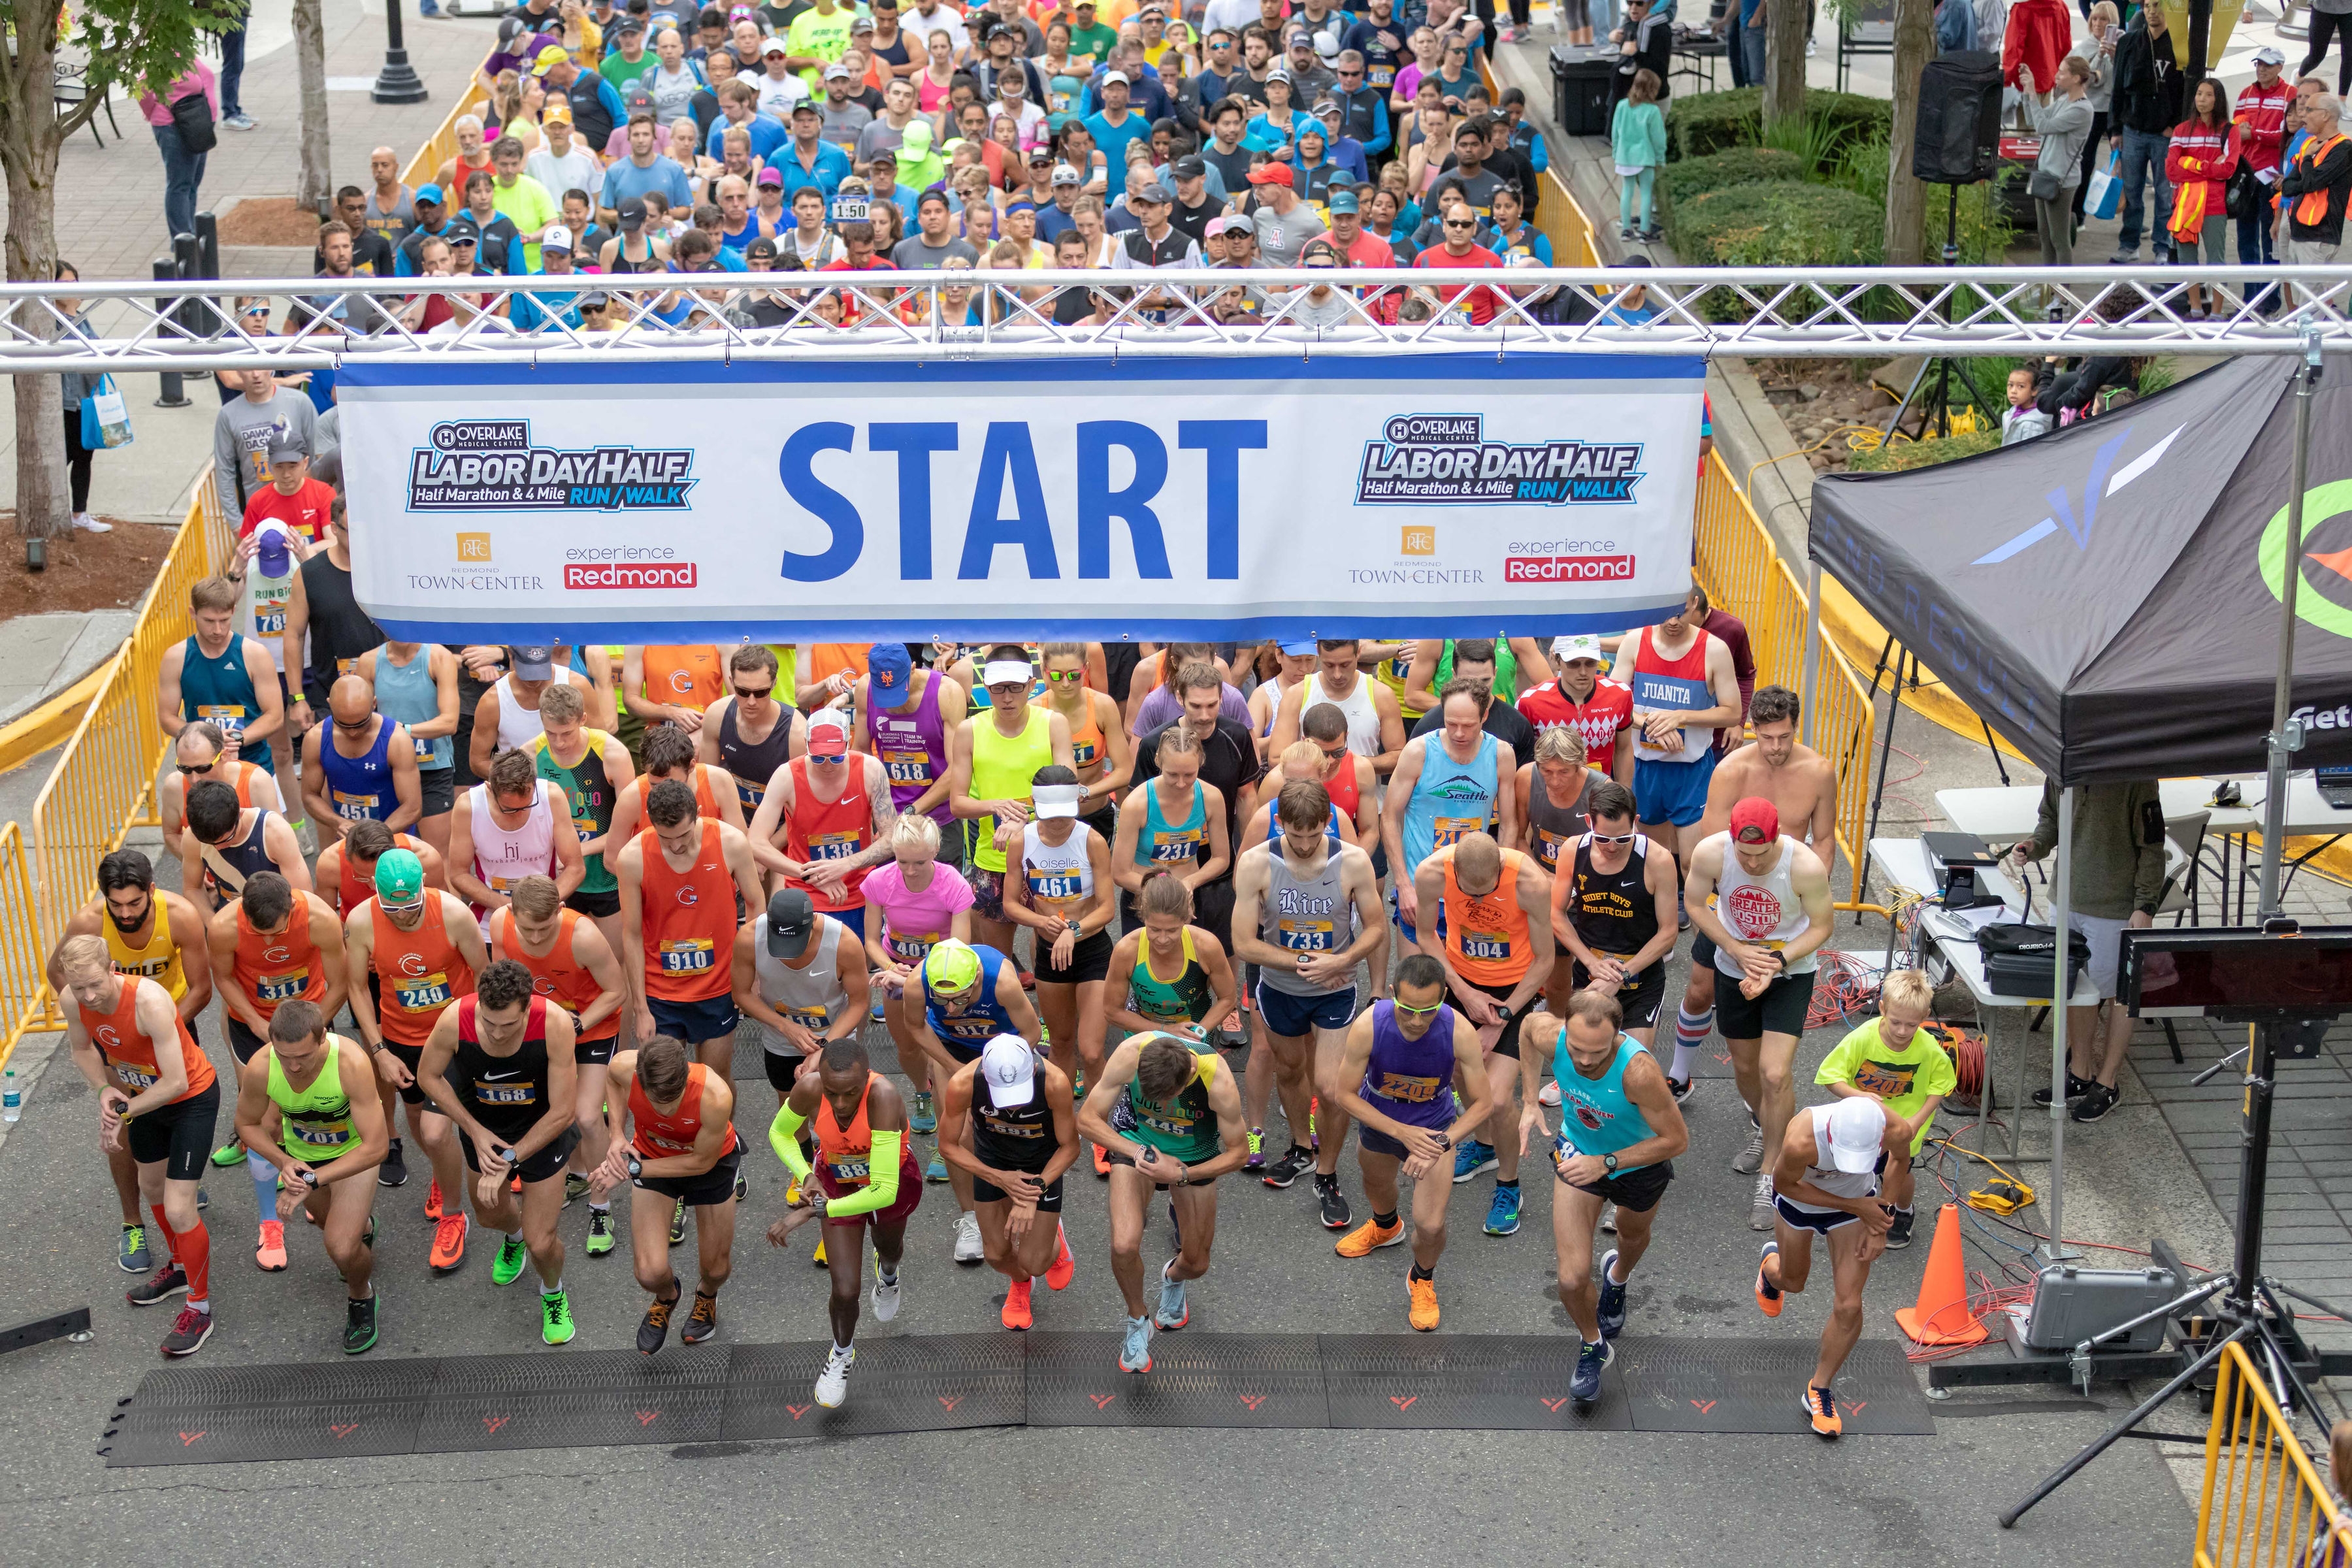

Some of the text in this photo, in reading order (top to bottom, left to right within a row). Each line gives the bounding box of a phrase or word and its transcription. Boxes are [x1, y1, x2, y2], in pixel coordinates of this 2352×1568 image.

[1371, 72, 1391, 84] 455
[838, 204, 866, 218] 1:50
[1266, 227, 1284, 250] A
[242, 427, 272, 441] DAWG
[457, 426, 523, 441] OVERLAKE
[1410, 420, 1475, 434] OVERLAKE
[416, 451, 525, 485] LABOR
[1366, 445, 1477, 479] LABOR
[416, 488, 444, 501] Half
[446, 487, 509, 501] Marathon
[512, 487, 523, 500] &
[525, 487, 535, 499] 4
[538, 486, 566, 500] Mile
[1364, 481, 1394, 495] Half
[1395, 481, 1458, 495] Marathon
[1461, 482, 1471, 494] &
[1474, 481, 1484, 493] 4
[1486, 480, 1514, 494] Mile
[779, 419, 1267, 582] START
[566, 544, 674, 563] experience
[1508, 537, 1615, 556] experience
[568, 563, 693, 587] Redmond
[1509, 555, 1631, 579] Redmond
[408, 575, 544, 590] TOWN CENTER
[1348, 569, 1485, 583] TOWN CENTER
[255, 590, 278, 599] RUN
[1642, 681, 1690, 704] JUANITA
[2289, 704, 2352, 731] Get
[890, 763, 924, 780] 618
[1446, 789, 1489, 801] Seattle
[340, 804, 370, 821] 451
[505, 843, 519, 860] hj
[818, 842, 853, 860] 138
[1158, 842, 1192, 861] 231
[1040, 858, 1079, 869] oiselle
[1039, 877, 1074, 897] 461
[1279, 889, 1333, 916] Rice
[1582, 892, 1631, 908] BIDET BOYS
[1729, 896, 1781, 913] GREATER
[1582, 904, 1633, 918] ATHLETIC CLUB
[1732, 908, 1778, 924] BOSTON
[896, 941, 930, 957] 401
[1287, 932, 1325, 951] 733
[1466, 939, 1502, 958] 304
[668, 952, 707, 970] 910
[264, 980, 302, 1000] 311
[404, 986, 444, 1007] 240
[954, 1024, 990, 1036] 917
[117, 1069, 152, 1088] 589
[1855, 1070, 1908, 1094] 2208
[486, 1088, 526, 1102] 168
[1379, 1080, 1436, 1097] 2209
[1562, 1089, 1614, 1119] TEAM RAVEN
[994, 1124, 1030, 1136] 591
[1145, 1117, 1185, 1135] 445
[302, 1132, 341, 1144] 701
[838, 1162, 870, 1178] 88
